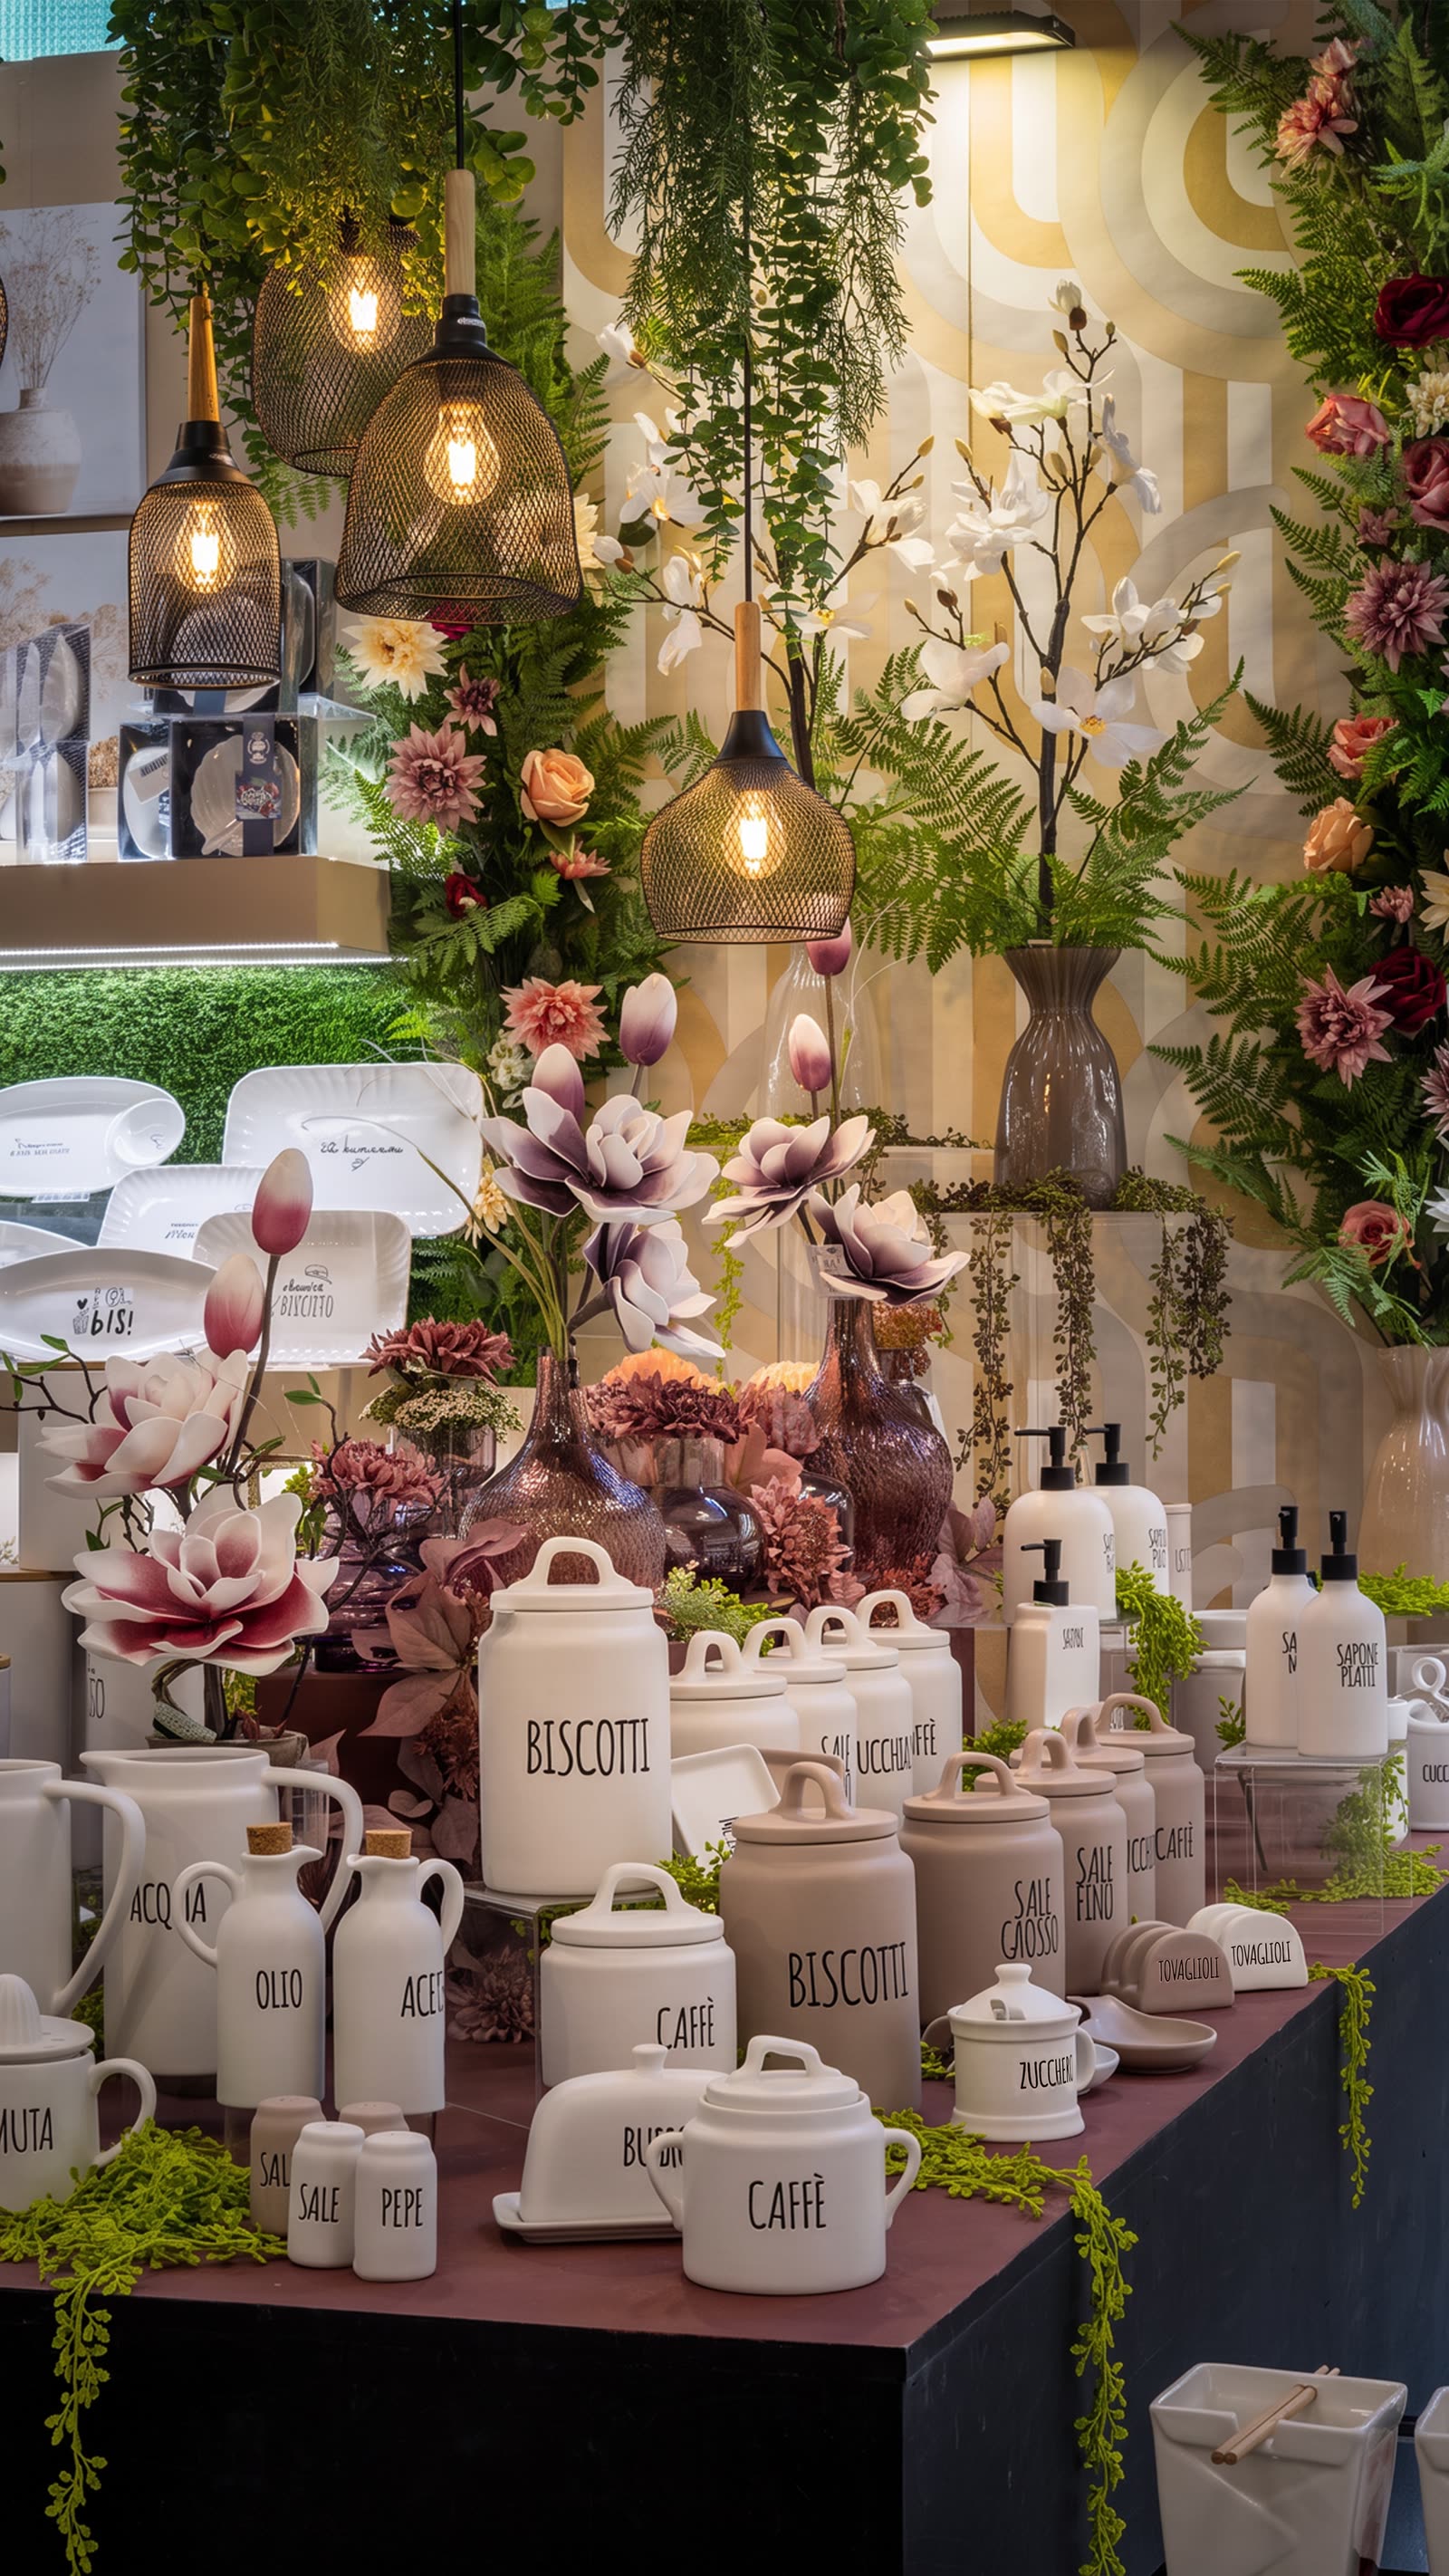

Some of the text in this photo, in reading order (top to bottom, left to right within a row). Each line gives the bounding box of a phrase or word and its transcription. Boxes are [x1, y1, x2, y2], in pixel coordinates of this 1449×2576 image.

[1337, 1642, 1378, 1667] SAPONE
[1341, 1665, 1376, 1687] PIATTI
[527, 1718, 650, 1776] BISCOTTI
[912, 1717, 937, 1756] FFÈ
[1423, 1764, 1449, 1783] CUCC
[1075, 1845, 1113, 1885] SALE
[1014, 1877, 1051, 1919] SALE
[1077, 1883, 1114, 1921] FINO
[1158, 1956, 1220, 1982] TOVAGLIOLI
[1231, 1940, 1291, 1966] TOVAGLIOLI
[256, 1968, 302, 2010] OLIO
[789, 1941, 909, 2008] BISCOTTI
[657, 1995, 715, 2050] CAFFÈ
[260, 2151, 291, 2187] SAL
[298, 2183, 341, 2223] SALE
[382, 2187, 423, 2228] PEPE
[748, 2172, 827, 2230] CAFFÈ
